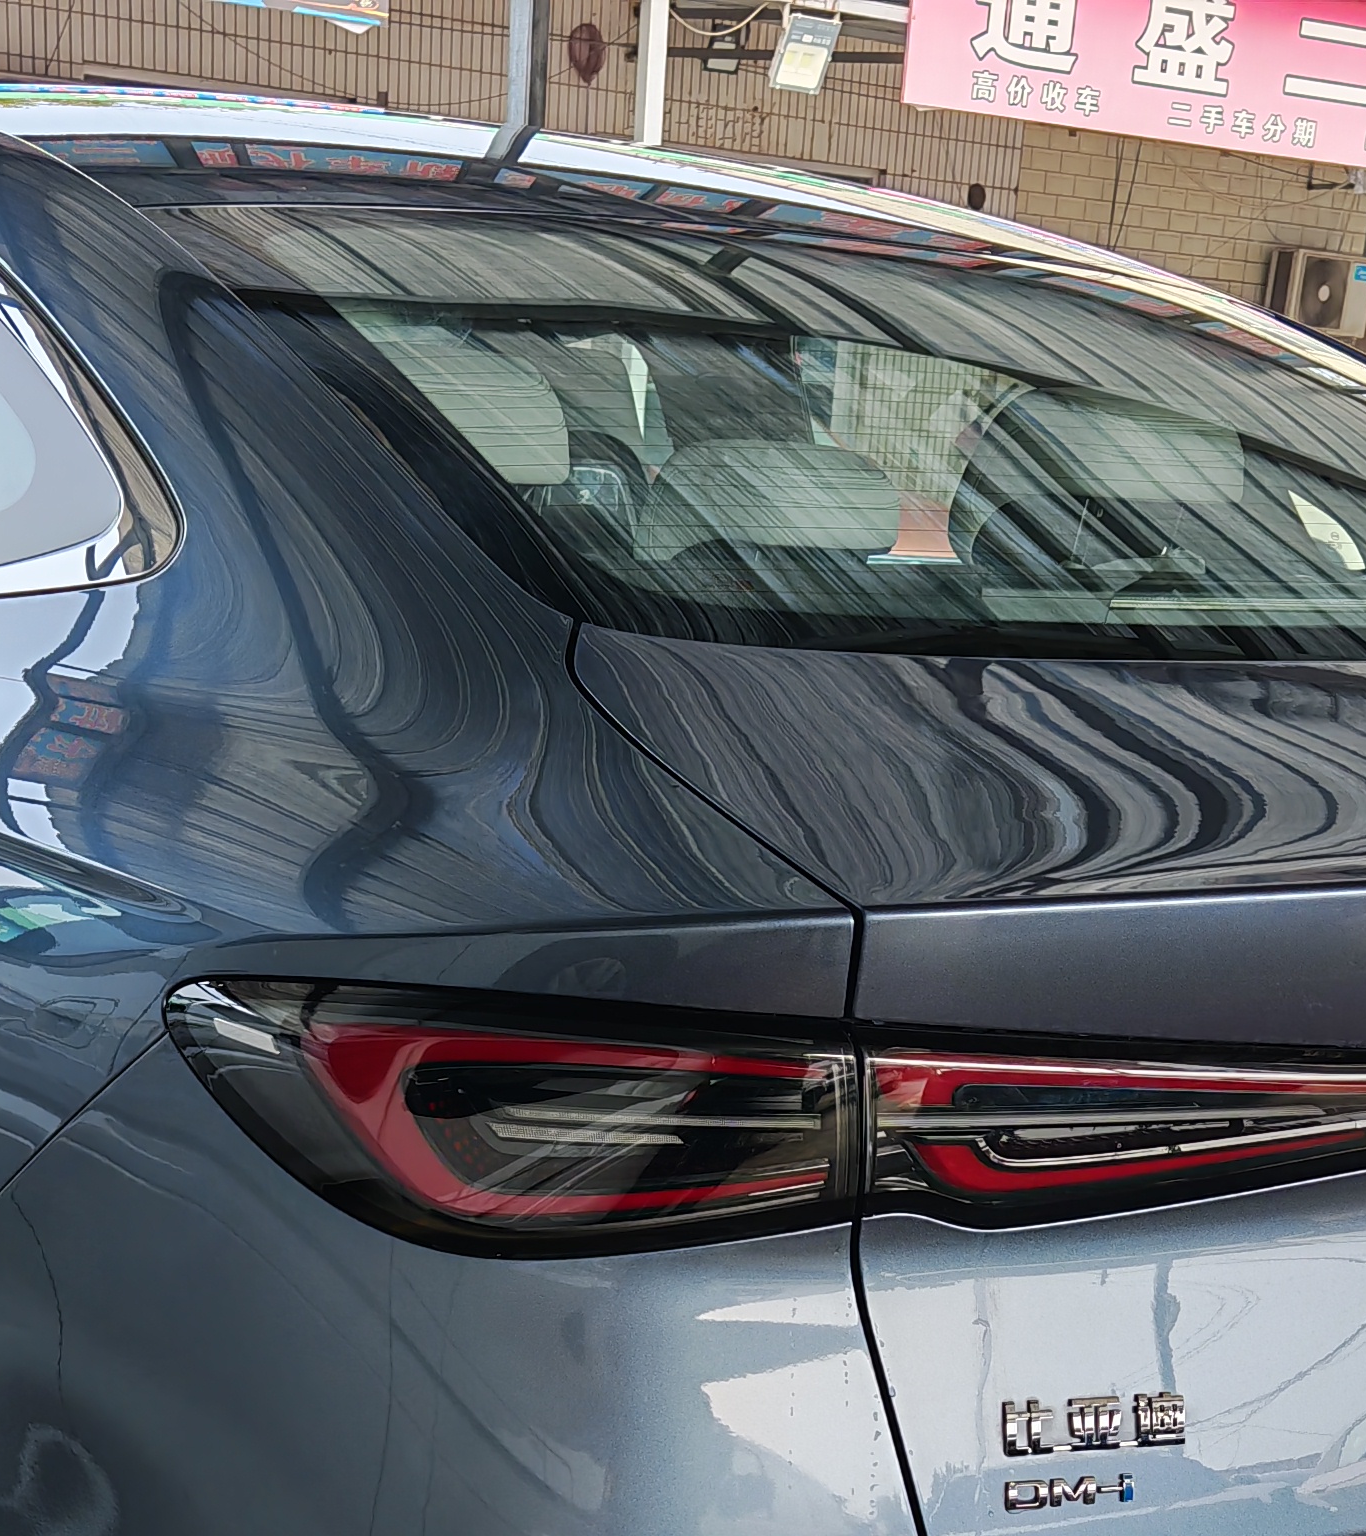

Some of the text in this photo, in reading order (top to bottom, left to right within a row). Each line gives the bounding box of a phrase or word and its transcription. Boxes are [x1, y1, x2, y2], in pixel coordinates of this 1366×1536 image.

[971, 70, 1102, 117] 高价收车
[1166, 101, 1318, 148] 二手车分期
[1001, 1391, 1186, 1458] 比亚迪
